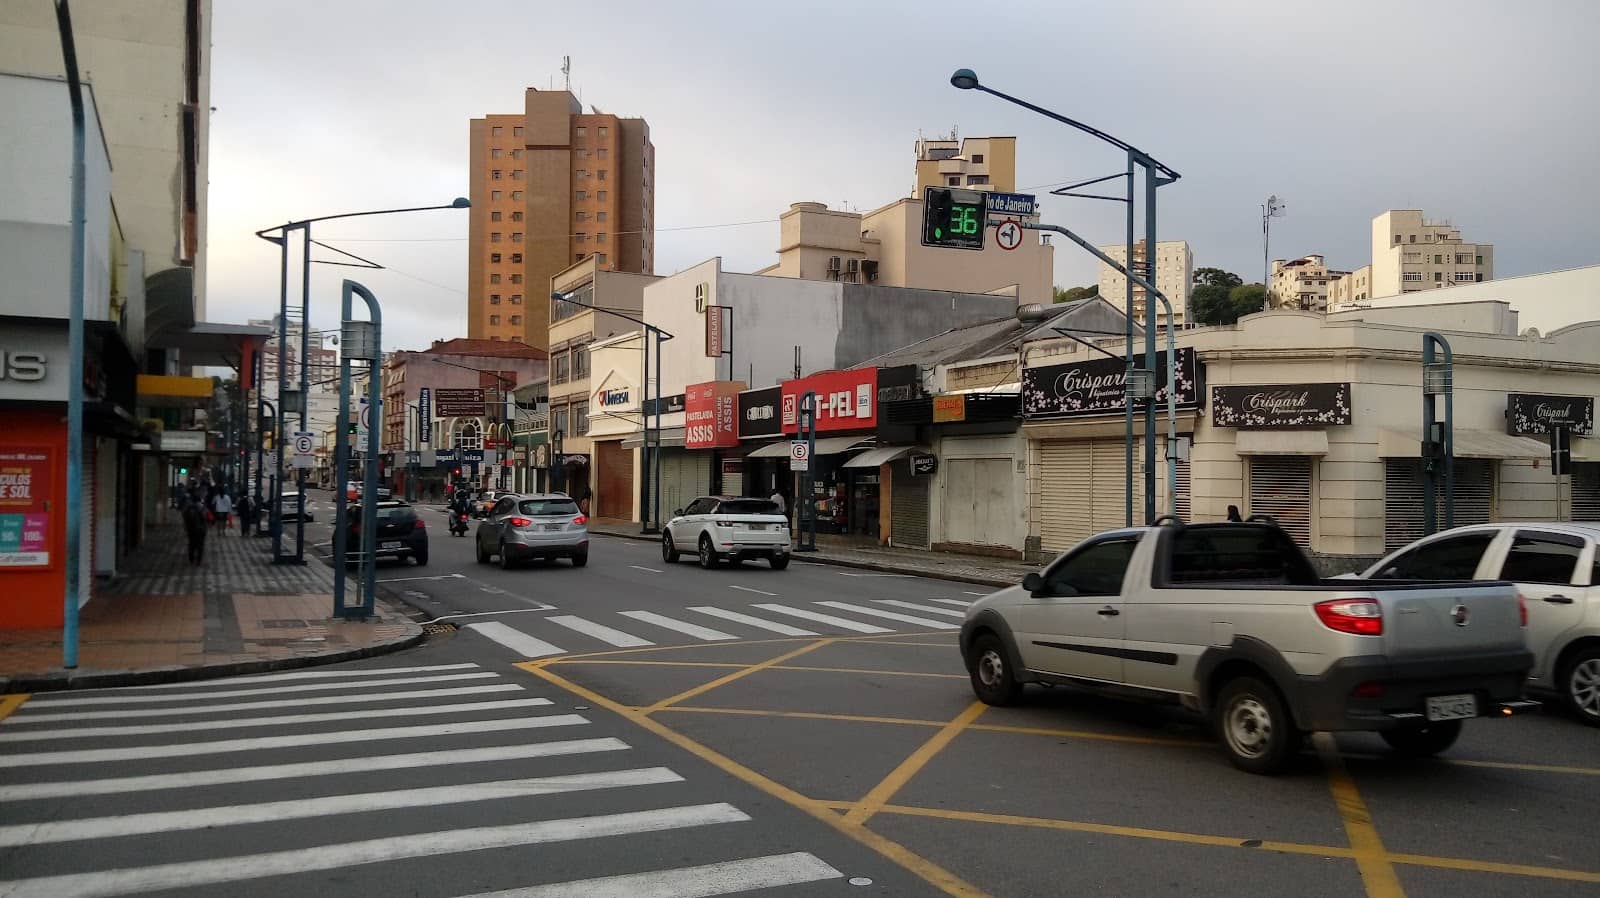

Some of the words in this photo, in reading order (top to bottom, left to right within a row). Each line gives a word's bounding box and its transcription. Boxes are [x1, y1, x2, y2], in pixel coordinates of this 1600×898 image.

[987, 193, 995, 209] io
[995, 195, 1005, 210] de
[1005, 195, 1031, 212] Janeiro
[950, 206, 977, 234] 36
[0, 351, 48, 381] S
[1241, 391, 1309, 415] Crispark
[1532, 402, 1572, 423] Crispark
[686, 410, 713, 421] PASTELARIA
[723, 396, 733, 432] ASSIS
[686, 425, 714, 443] ASSIS
[301, 440, 307, 449] E
[797, 447, 802, 455] E
[9, 485, 32, 498] SOL
